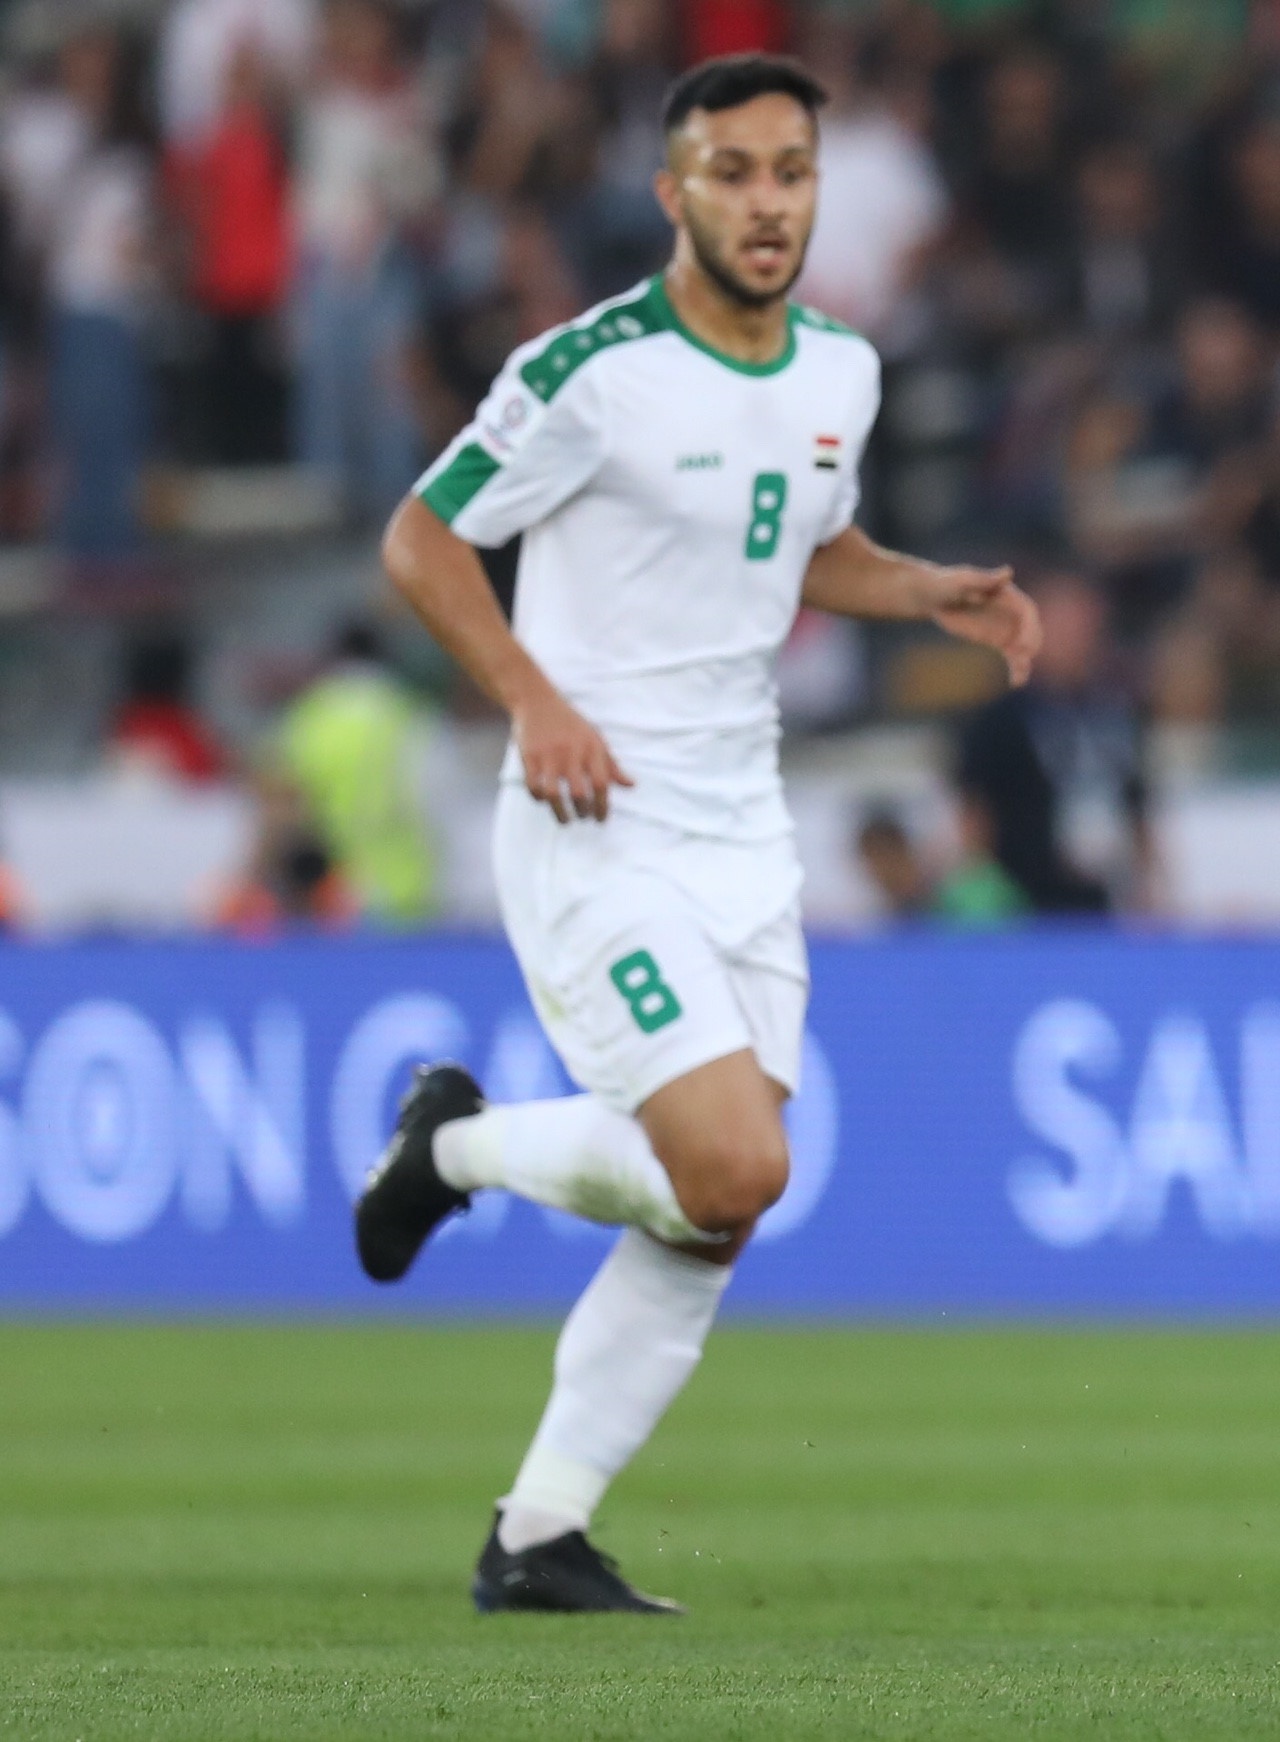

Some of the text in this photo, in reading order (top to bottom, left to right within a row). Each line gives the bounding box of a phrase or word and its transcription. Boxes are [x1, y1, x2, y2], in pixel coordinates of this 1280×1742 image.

[745, 470, 788, 561] 8
[610, 948, 682, 1034] 8
[0, 992, 306, 1245] ON
